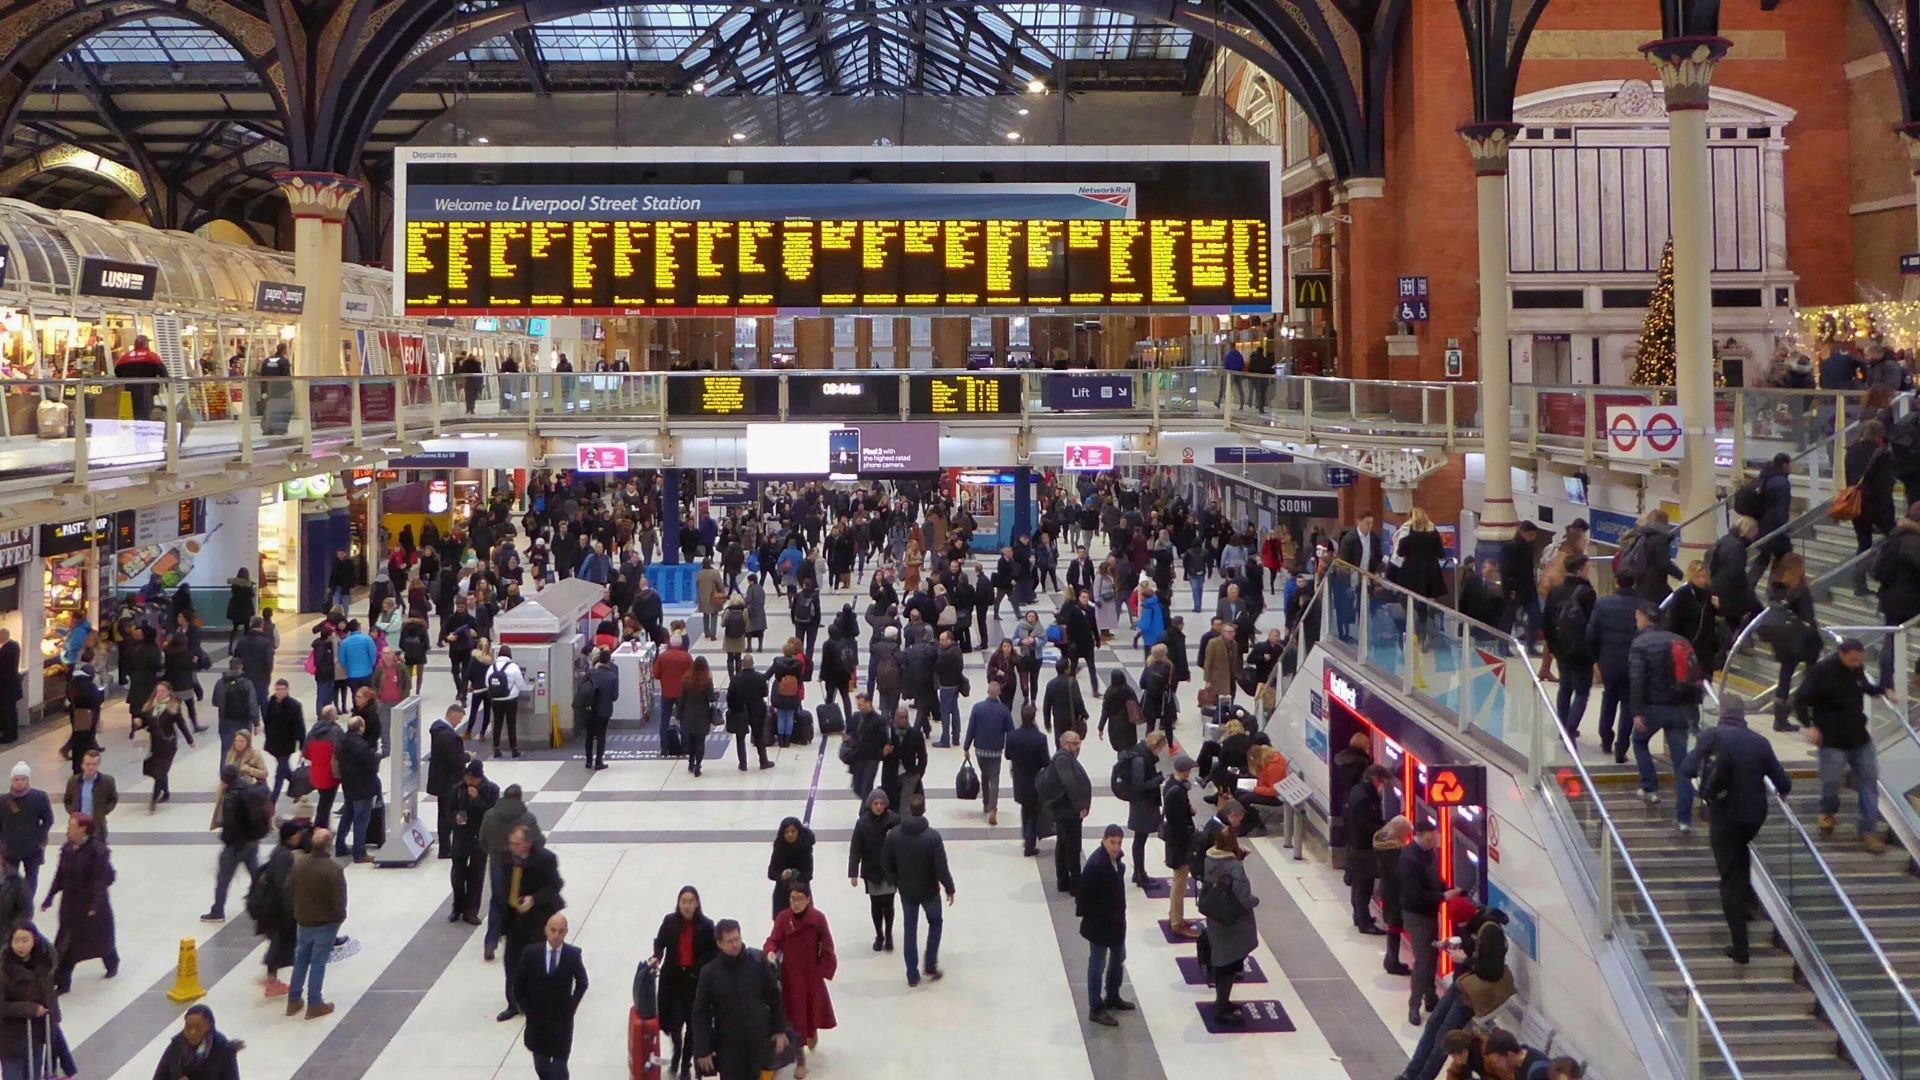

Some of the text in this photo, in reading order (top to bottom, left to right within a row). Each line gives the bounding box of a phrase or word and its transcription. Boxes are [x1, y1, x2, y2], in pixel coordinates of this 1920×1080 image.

[412, 151, 458, 160] Departures
[435, 195, 701, 214] Welcome to Liverpool Street Station
[101, 270, 132, 289] LUSH
[1072, 387, 1090, 398] Lift
[883, 447, 896, 455] with
[1280, 499, 1312, 513] SOON!
[62, 522, 86, 536] PAST
